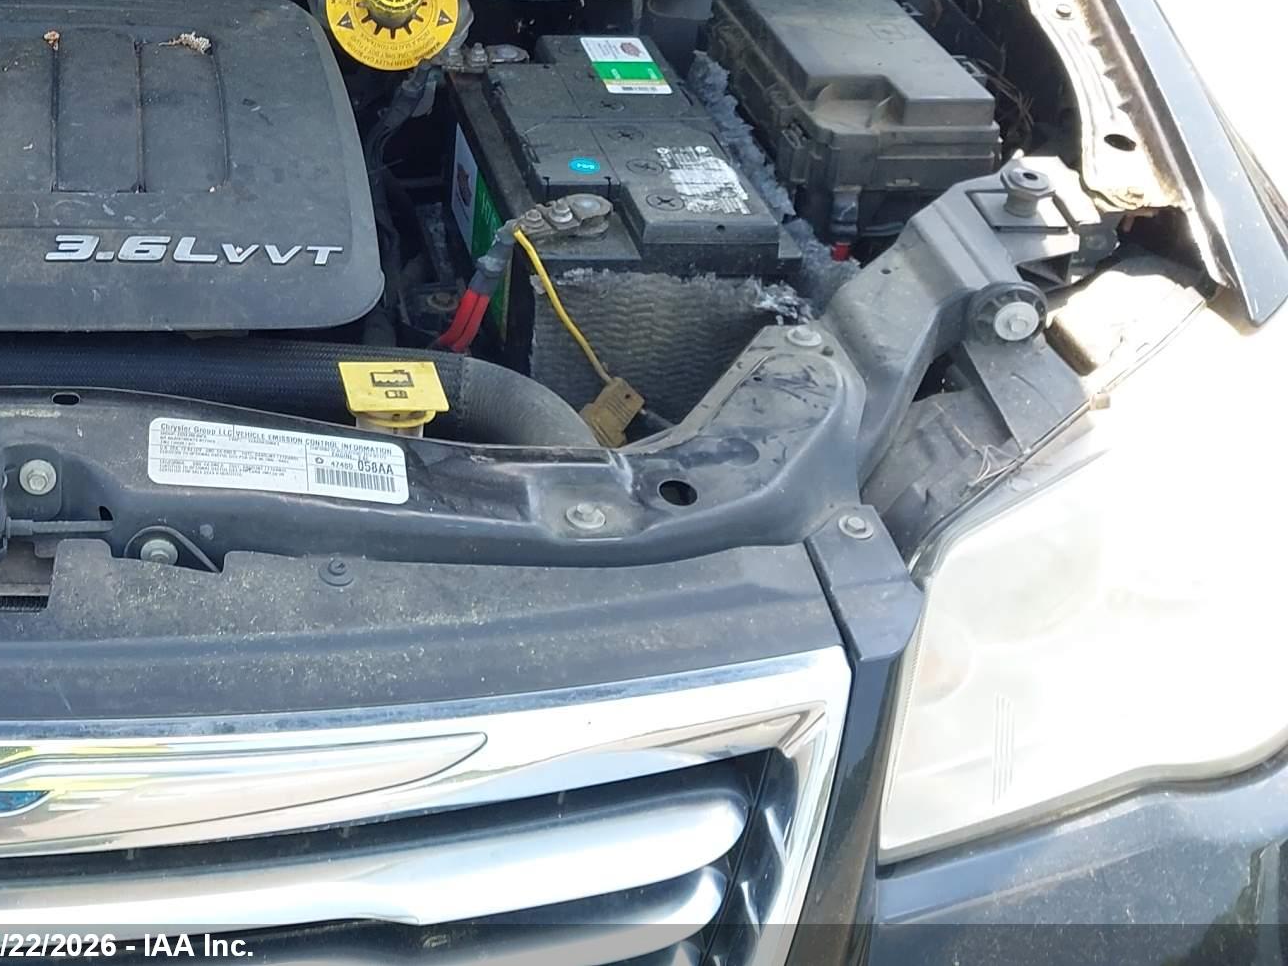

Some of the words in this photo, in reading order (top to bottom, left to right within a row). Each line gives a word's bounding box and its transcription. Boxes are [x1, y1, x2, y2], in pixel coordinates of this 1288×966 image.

[160, 423, 191, 434] Chrysler
[194, 425, 216, 436] Group
[218, 426, 233, 437] LLC
[236, 429, 265, 441] VEHICLE
[268, 432, 303, 445] EMISSION
[306, 437, 337, 449] CONTROL
[341, 441, 392, 456] INFORMATION
[357, 459, 394, 475] 058AA
